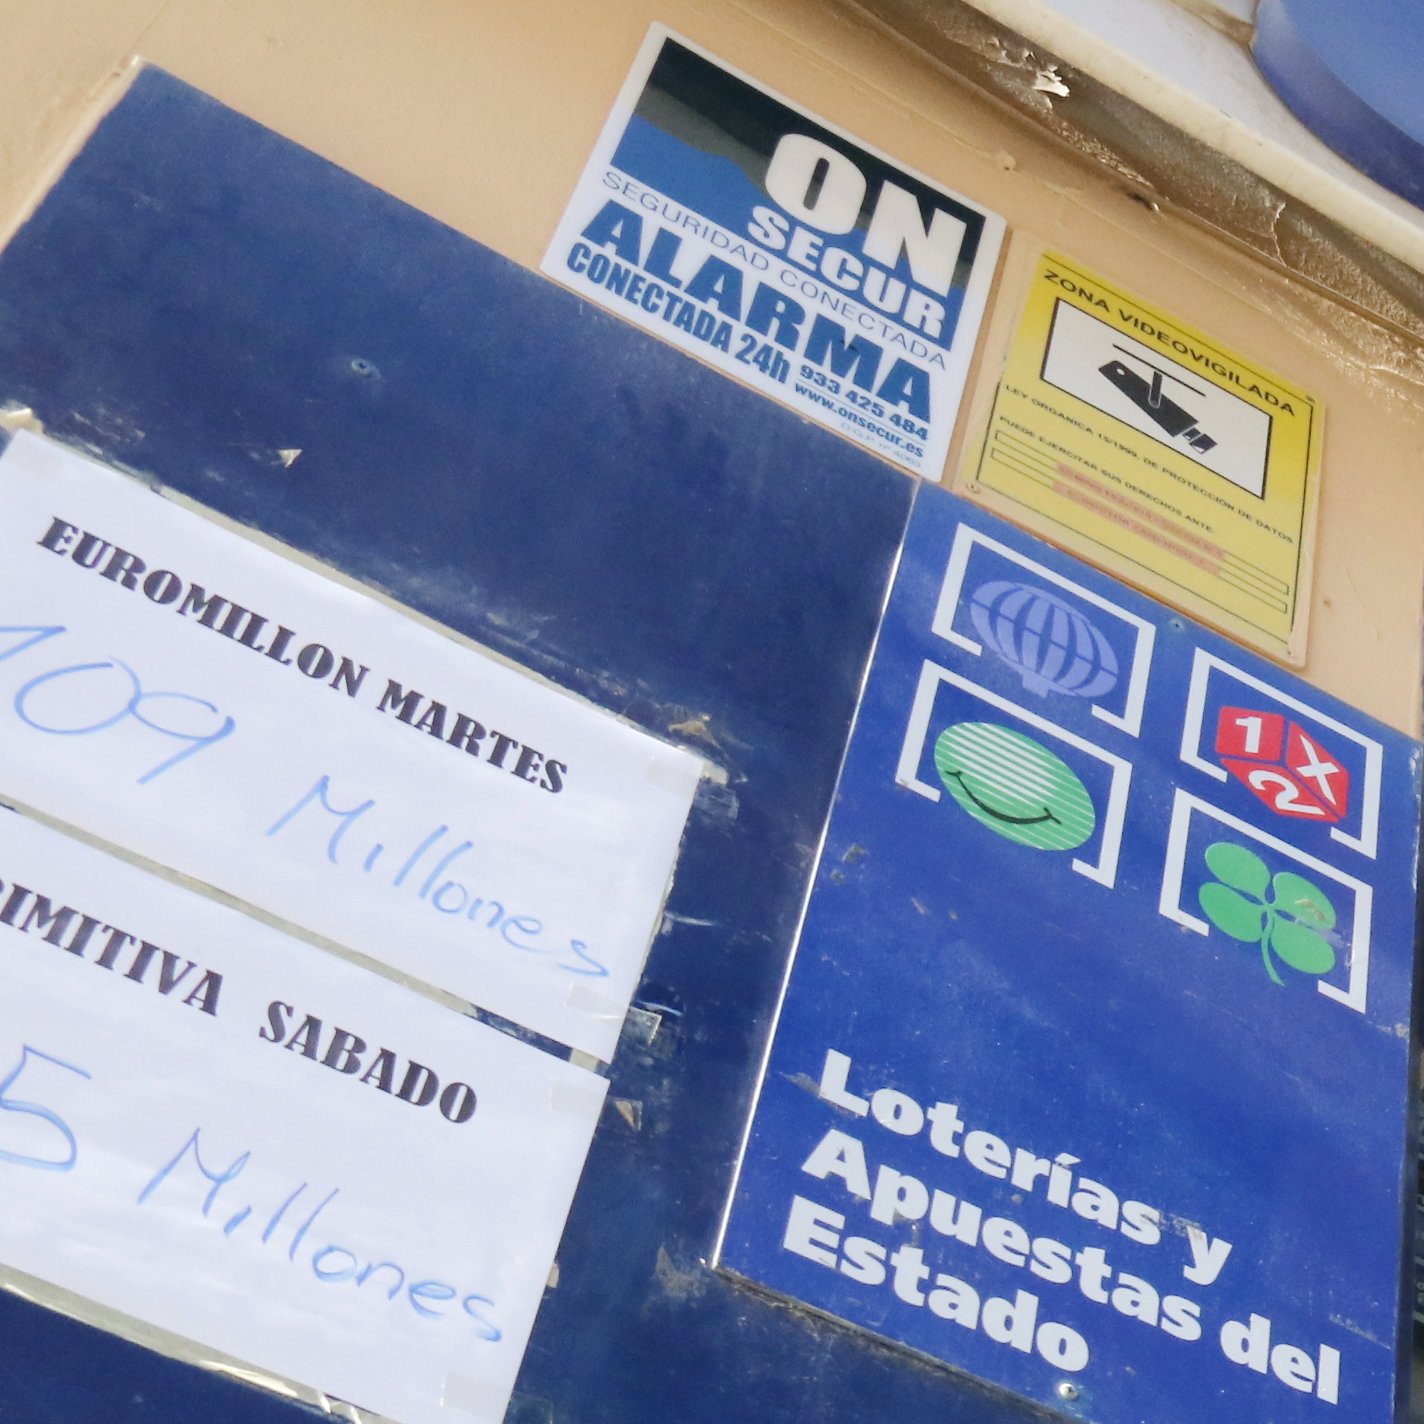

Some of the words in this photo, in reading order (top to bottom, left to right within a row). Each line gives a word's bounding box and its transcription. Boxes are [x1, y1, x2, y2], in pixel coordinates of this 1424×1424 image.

[602, 170, 769, 271] SEGURIDAD
[780, 269, 946, 370] CONECTADA
[748, 205, 947, 339] SECUR
[765, 132, 966, 297] ON
[566, 241, 733, 353] CONECTADA
[735, 334, 791, 383] 24h
[580, 199, 931, 424] ALARMA
[1044, 269, 1111, 312] ZONA
[1118, 308, 1295, 416] VIDEOVIGILADA
[795, 383, 923, 457] www.onsecur.es
[800, 365, 841, 394] 933
[846, 390, 884, 417] 425
[889, 413, 928, 440] 484
[1000, 416, 1035, 437] PUEDE
[1039, 436, 1098, 471] EJERCITAR
[1100, 468, 1123, 482] SUS
[1125, 480, 1182, 516] DERECHOS
[1005, 385, 1028, 399] LEY
[1143, 456, 1159, 466] DE
[1238, 508, 1253, 520] DE
[1256, 515, 1294, 544] DATOS
[35, 516, 371, 698] EUROMILLON
[376, 678, 568, 795] MARTES
[267, 775, 609, 977] Millones
[0, 879, 226, 1017] IMITIVA
[259, 1000, 477, 1124] SABADO
[136, 1127, 503, 1342] Millones
[819, 1048, 1163, 1247] Loterías
[1182, 1223, 1234, 1287] y
[782, 1195, 1091, 1373] Estado
[801, 1129, 1204, 1343] Apuestas
[1218, 1312, 1341, 1406] del
